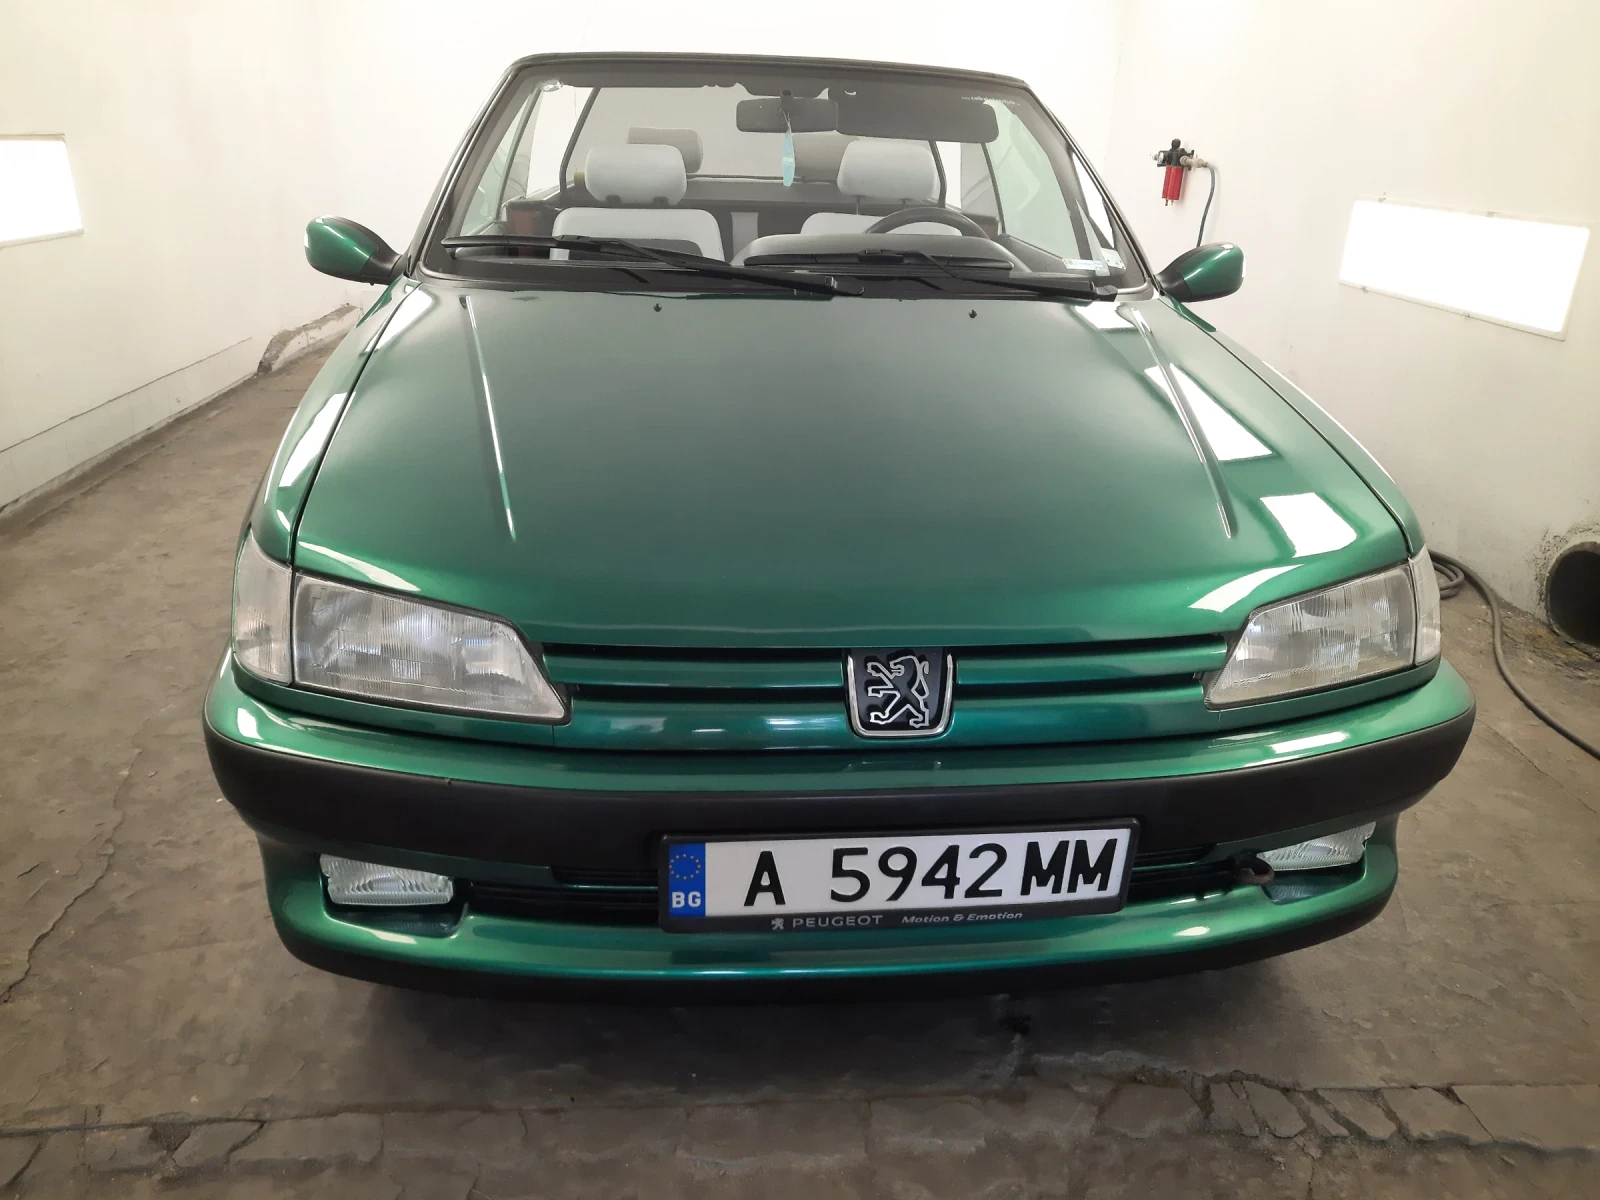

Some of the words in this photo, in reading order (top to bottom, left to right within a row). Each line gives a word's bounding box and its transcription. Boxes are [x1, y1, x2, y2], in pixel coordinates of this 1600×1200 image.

[743, 850, 786, 907] A
[830, 842, 1008, 903] 5942
[1020, 838, 1118, 896] MM
[671, 891, 702, 908] BG
[792, 914, 884, 928] PEUGEOT
[901, 913, 950, 924] Motion
[952, 913, 965, 922] &
[966, 911, 1023, 922] Emotion
